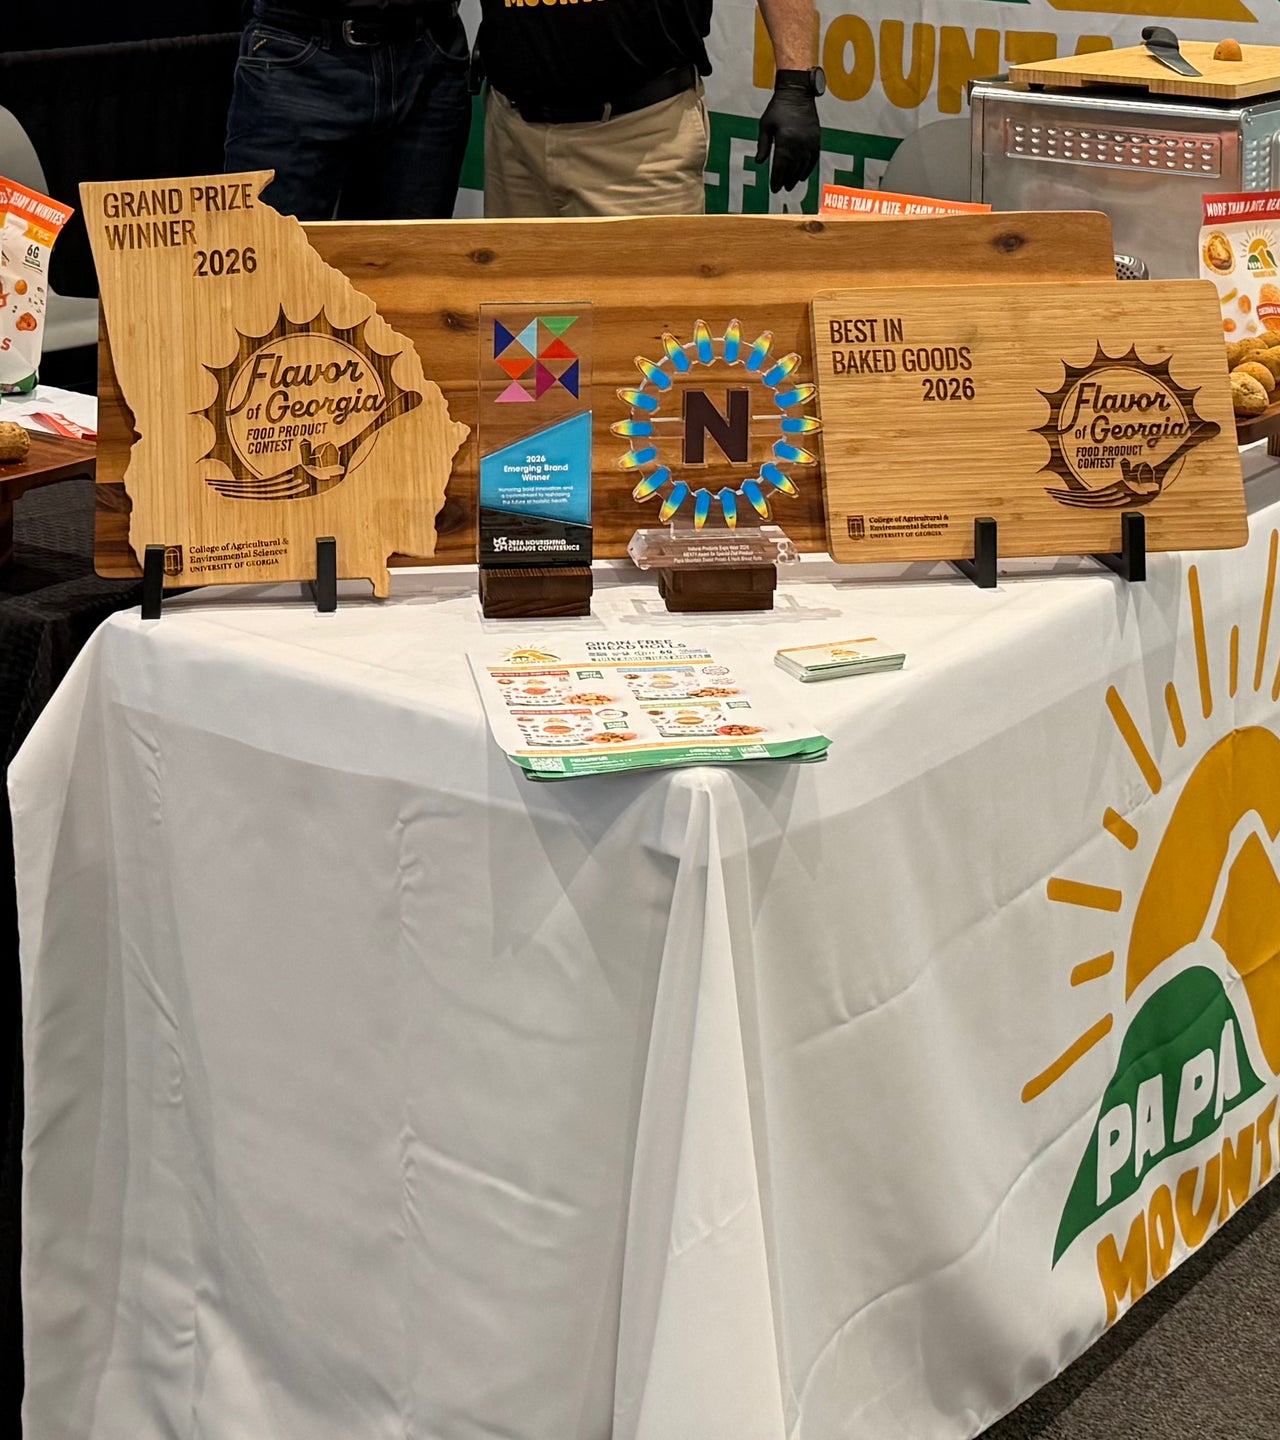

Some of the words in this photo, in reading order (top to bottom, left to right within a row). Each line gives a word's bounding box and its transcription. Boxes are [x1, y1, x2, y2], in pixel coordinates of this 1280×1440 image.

[103, 188, 183, 218] GRAND
[189, 183, 254, 212] PRIZE
[824, 193, 848, 209] MORE
[851, 197, 872, 212] THAN
[1206, 203, 1227, 217] MORE
[105, 220, 197, 250] WINNER
[27, 244, 39, 258] 6G
[193, 247, 257, 277] 2026
[829, 319, 877, 344] BEST
[883, 318, 904, 343] IN
[832, 349, 897, 375] BAKED
[902, 346, 972, 372] GOODS
[226, 353, 364, 416] Flavor
[922, 377, 975, 401] 2026
[247, 404, 262, 420] of
[266, 388, 388, 425] Georgia
[1058, 382, 1171, 434] Flavor
[246, 427, 275, 441] FOOD
[278, 422, 328, 438] PRODUCT
[682, 389, 752, 467] N
[1075, 426, 1087, 439] of
[1090, 415, 1191, 448] Georgia
[247, 439, 294, 455] CONTEST
[1076, 447, 1099, 457] FOOD
[1102, 445, 1143, 456] PRODUCT
[504, 464, 541, 473] Emerging
[526, 455, 546, 463] 2026
[1078, 458, 1116, 469] CONTEST
[869, 516, 891, 524] College
[870, 523, 919, 531] Environmental
[189, 545, 220, 554] College
[221, 543, 230, 551] of
[230, 538, 279, 551] Agricultural
[190, 550, 251, 564] Environmental
[253, 548, 288, 557] Sciences
[189, 562, 233, 573] UNIVERSITY
[246, 559, 279, 567] GEORGIA
[1097, 1018, 1241, 1206] PAPA
